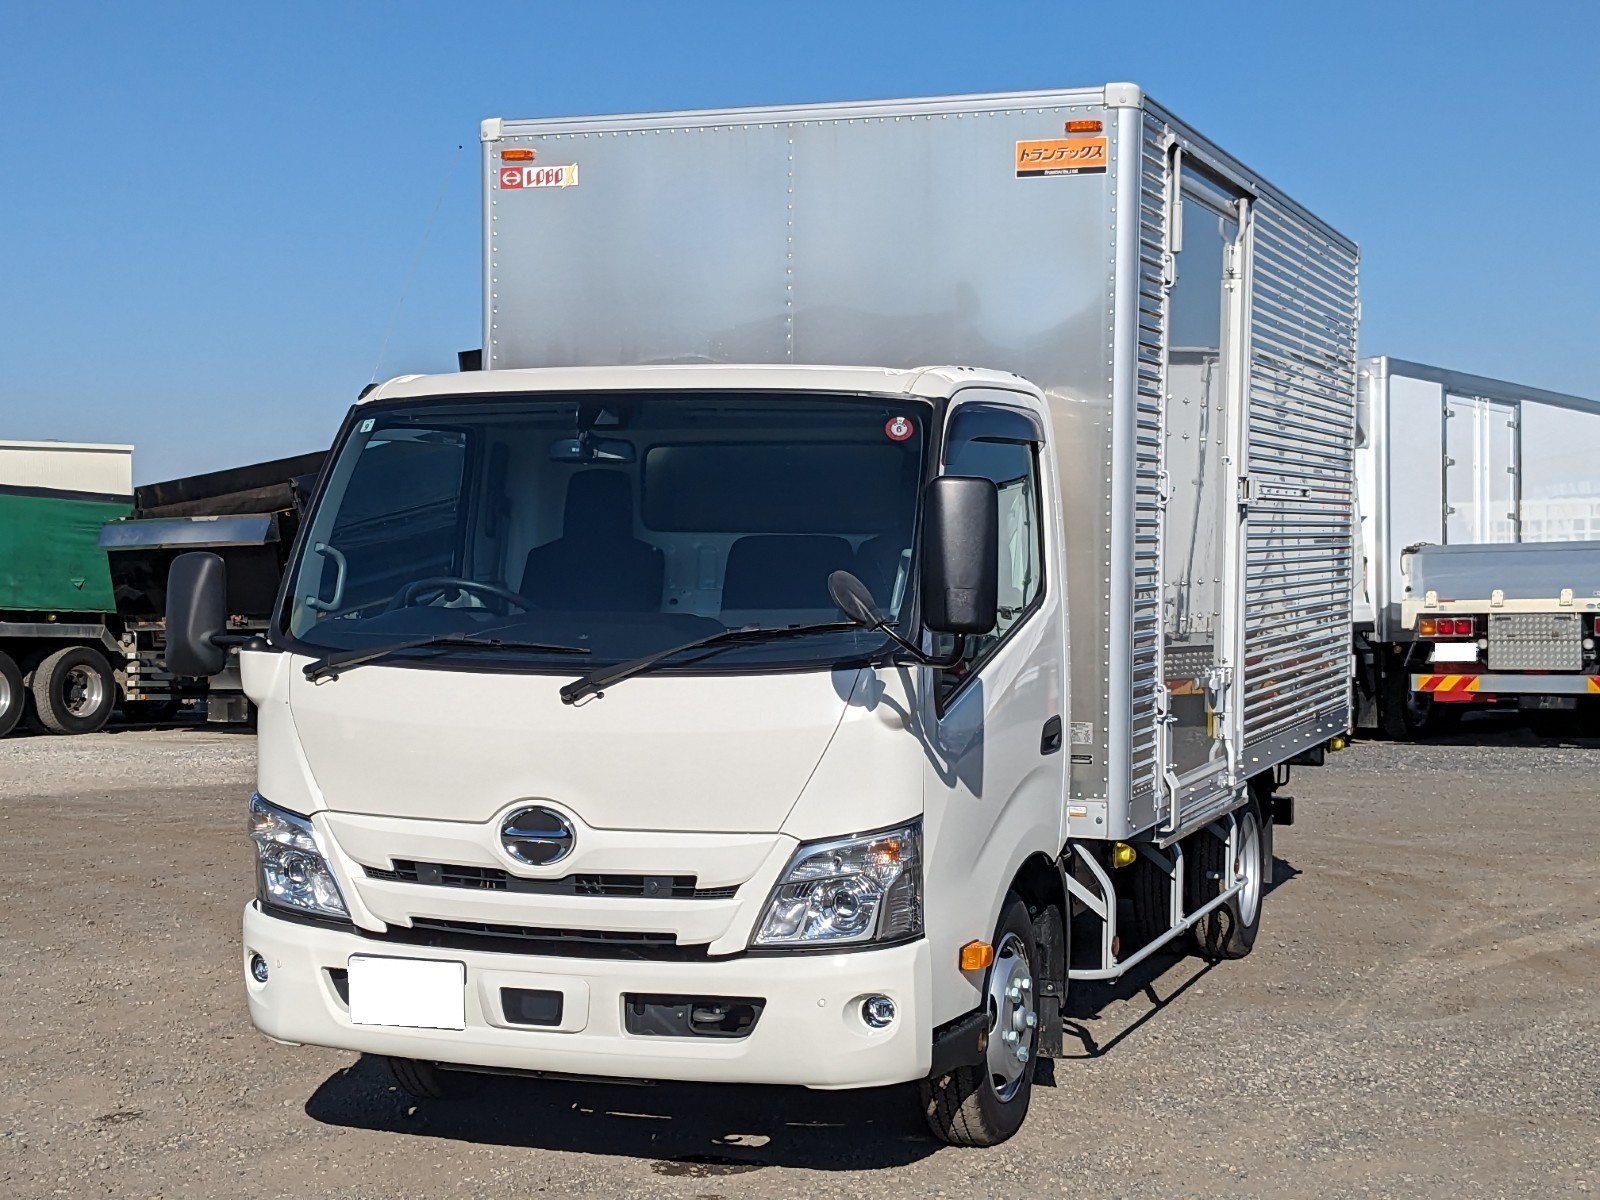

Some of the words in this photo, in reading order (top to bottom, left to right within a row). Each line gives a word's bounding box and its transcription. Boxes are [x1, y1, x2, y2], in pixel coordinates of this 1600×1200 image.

[1020, 145, 1103, 162] トランテックス
